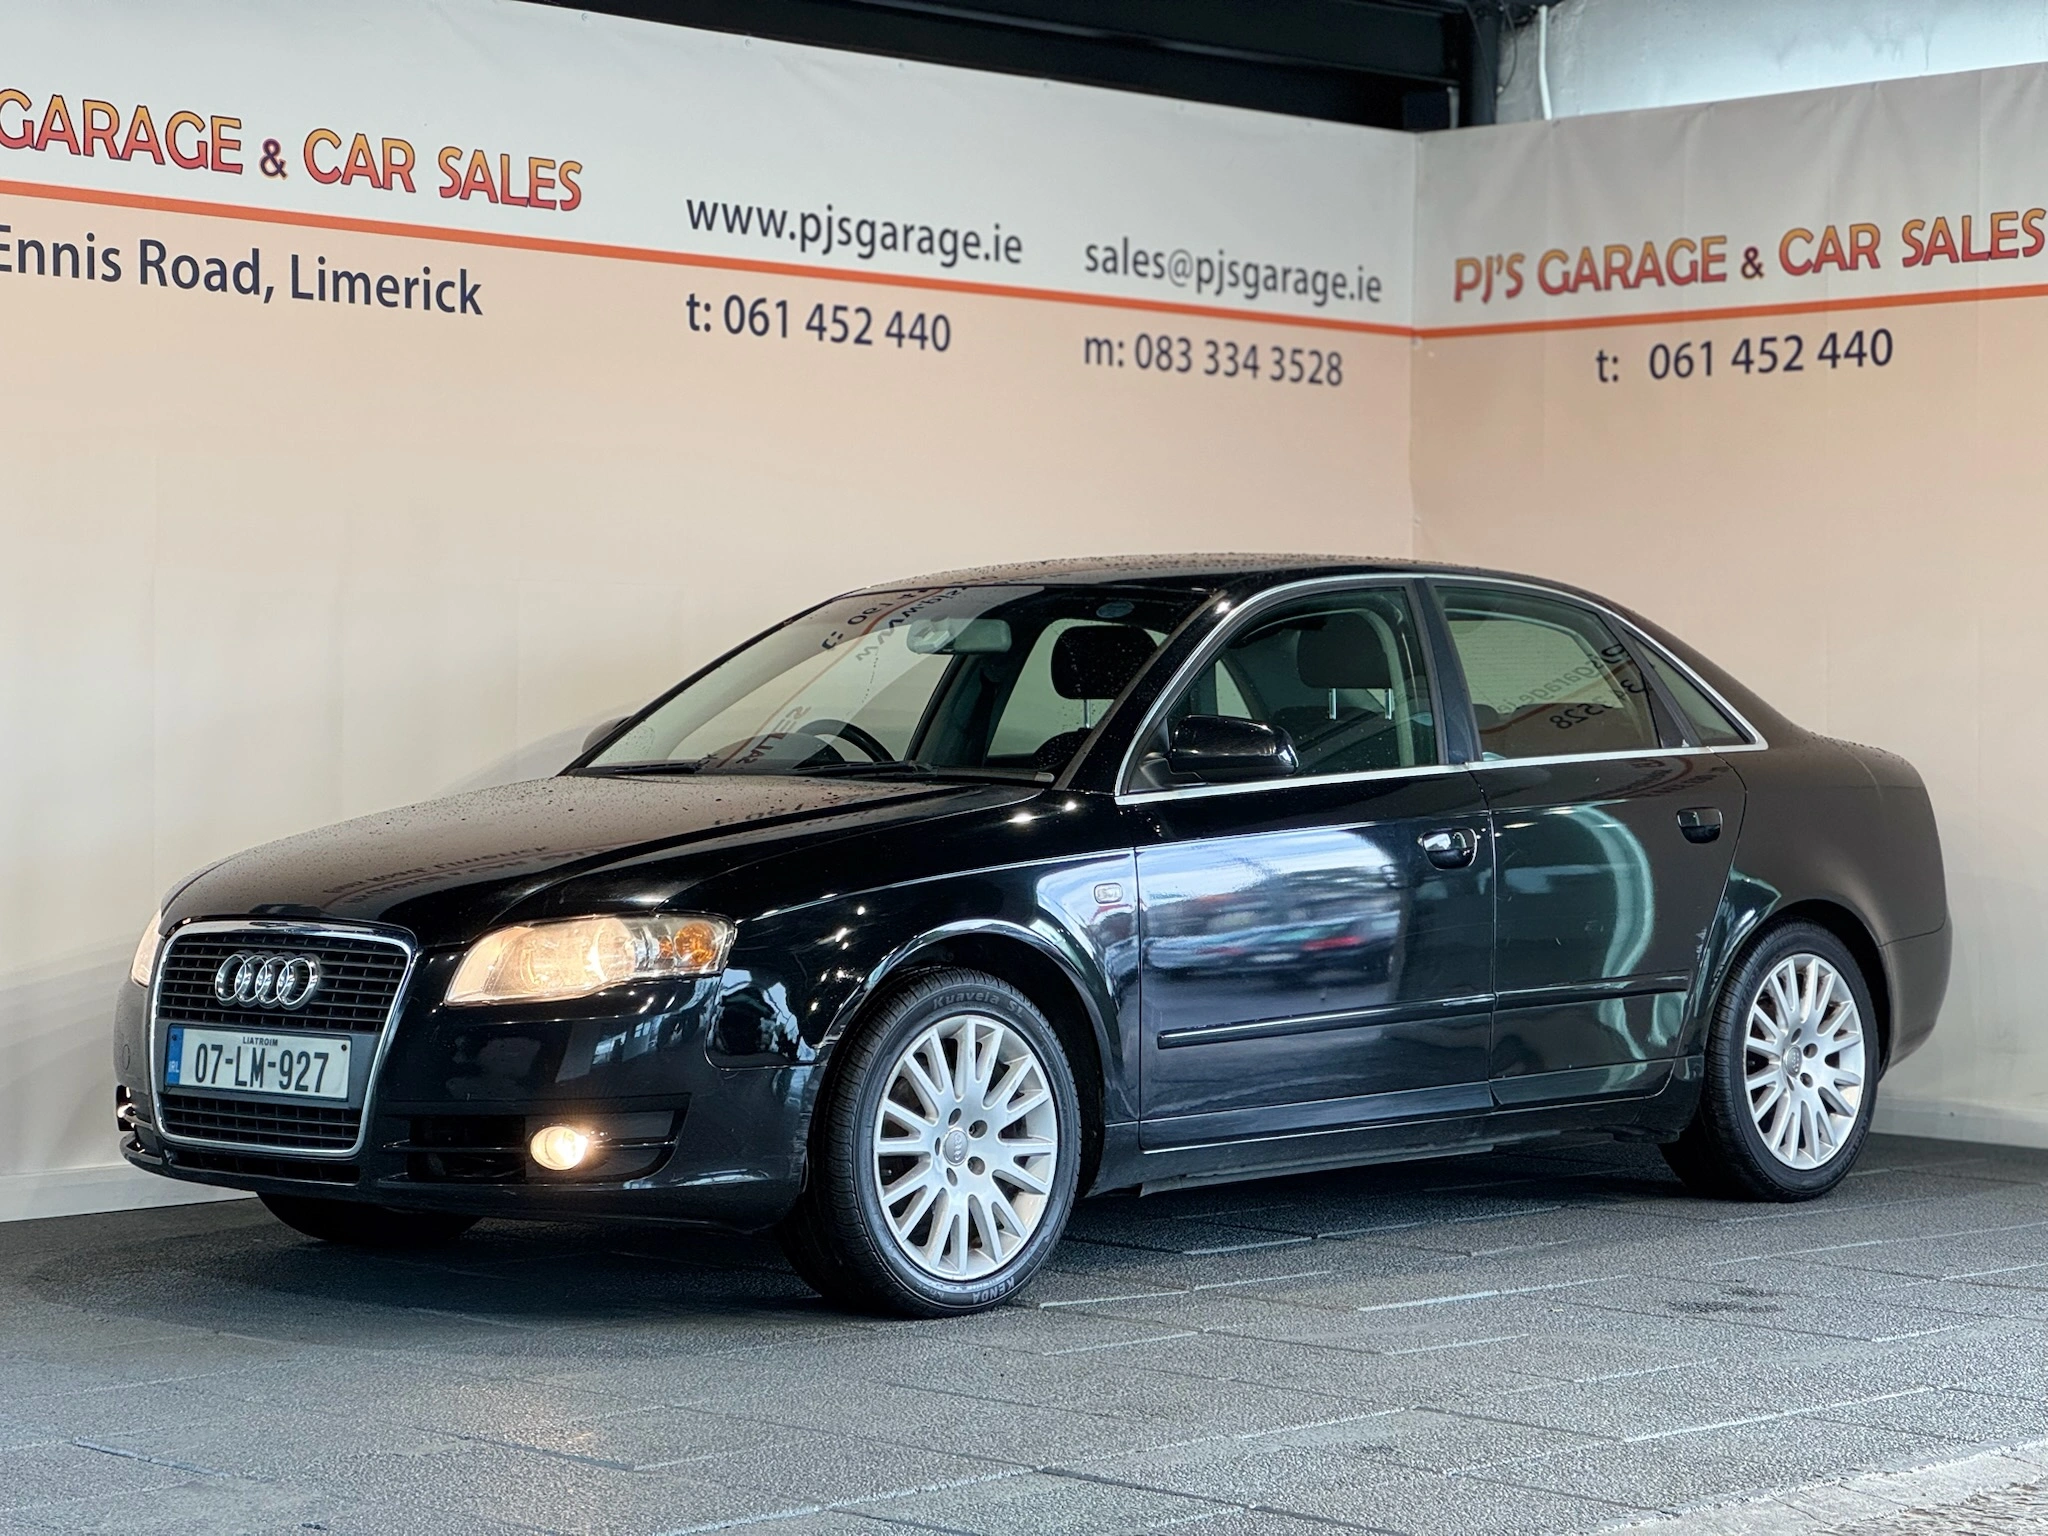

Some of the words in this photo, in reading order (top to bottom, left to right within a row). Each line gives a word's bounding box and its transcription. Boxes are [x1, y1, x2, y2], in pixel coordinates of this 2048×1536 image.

[0, 88, 243, 175] GARAGE
[259, 139, 288, 180] &
[303, 128, 416, 193] CAR
[438, 146, 583, 211] SALES
[685, 199, 1023, 268] www.pjsgarage.ie
[1455, 253, 1524, 303] PJ'S
[1538, 236, 1727, 295] GARAGE
[1741, 247, 1764, 279] &
[1779, 223, 1880, 276] CAR
[1902, 207, 2047, 267] SALES
[0, 225, 121, 282] Ennis
[140, 239, 274, 303] Road,
[291, 254, 483, 315] Limerick
[1085, 237, 1382, 306] sales@pjsgarage.ie
[686, 293, 711, 332] t:
[724, 295, 787, 338] 061
[805, 303, 873, 346] 452
[885, 311, 951, 352] 440
[1085, 338, 1124, 367] m:
[1135, 333, 1192, 373] 083
[1204, 340, 1260, 378] 334
[1270, 346, 1342, 386] 3528
[1596, 350, 1618, 383] t:
[1649, 341, 1712, 380] 061
[1731, 335, 1804, 374] 452
[1817, 328, 1893, 369] 440
[194, 1043, 330, 1094] 07-LM-927
[242, 1036, 279, 1047] LIATROIM
[971, 1276, 1016, 1304] KENDA
